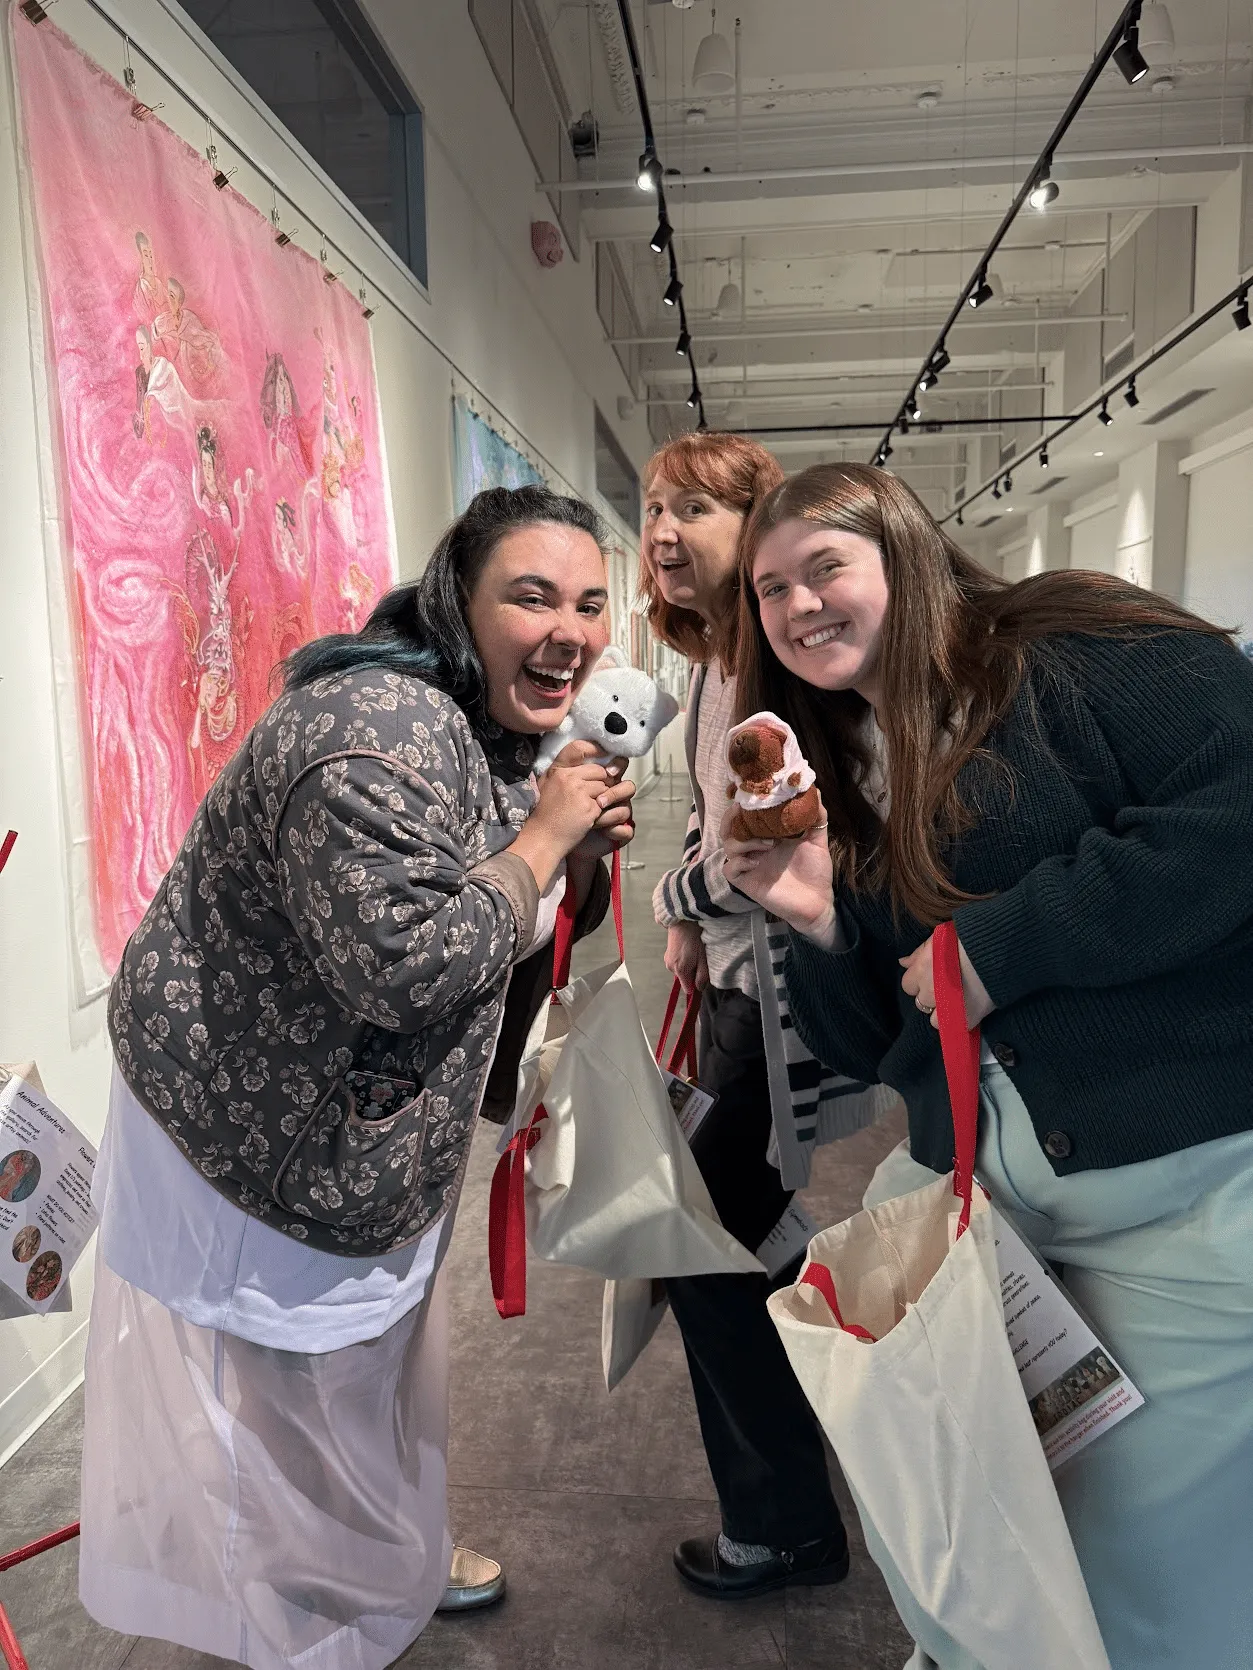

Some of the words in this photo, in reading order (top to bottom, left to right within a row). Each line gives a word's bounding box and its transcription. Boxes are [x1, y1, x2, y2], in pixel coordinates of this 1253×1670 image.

[16, 1091, 40, 1108] Animal
[37, 1107, 66, 1134] Adventures
[19, 1125, 33, 1136] search
[26, 1121, 41, 1136] through
[78, 1147, 94, 1165] Flowers
[1116, 1387, 1125, 1397] and
[1108, 1401, 1123, 1413] Thank
